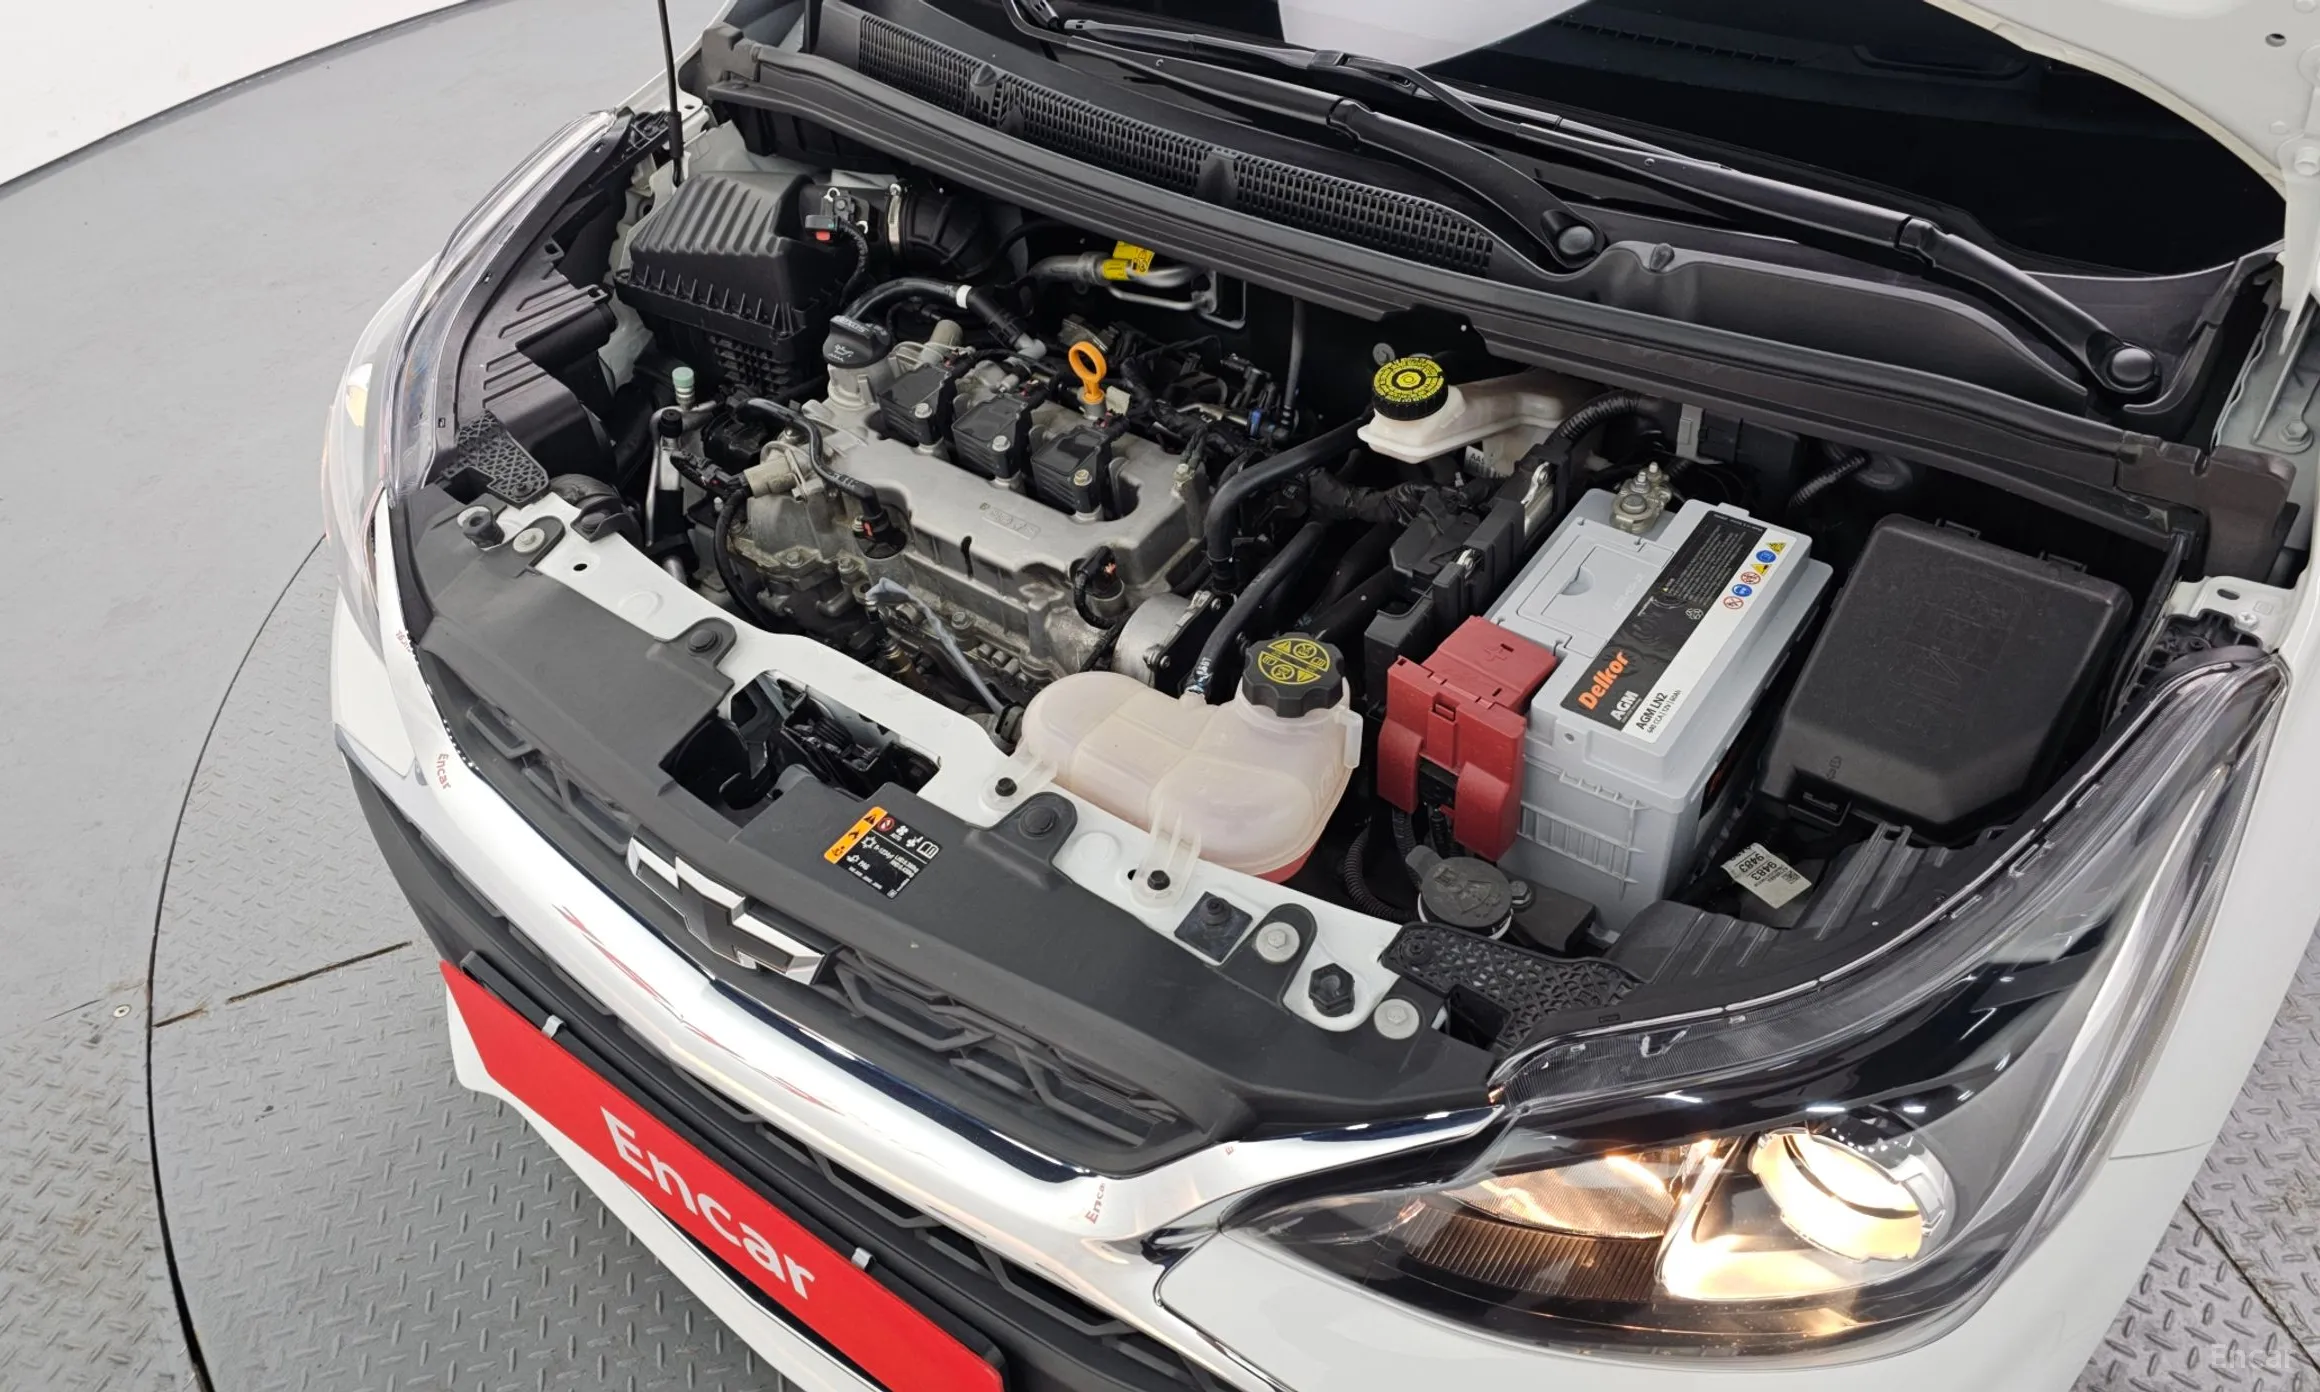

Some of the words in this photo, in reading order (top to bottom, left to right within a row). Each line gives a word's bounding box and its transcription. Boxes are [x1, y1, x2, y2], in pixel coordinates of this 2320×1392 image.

[1578, 650, 1629, 710] Delkor
[1610, 690, 1640, 722] AGM
[1635, 707, 1656, 730] AGM
[1649, 691, 1668, 710] LN2
[436, 753, 452, 789] Encar
[1738, 853, 1765, 873] 9483
[1750, 861, 1777, 881] 9483
[600, 1105, 816, 1300] Encar
